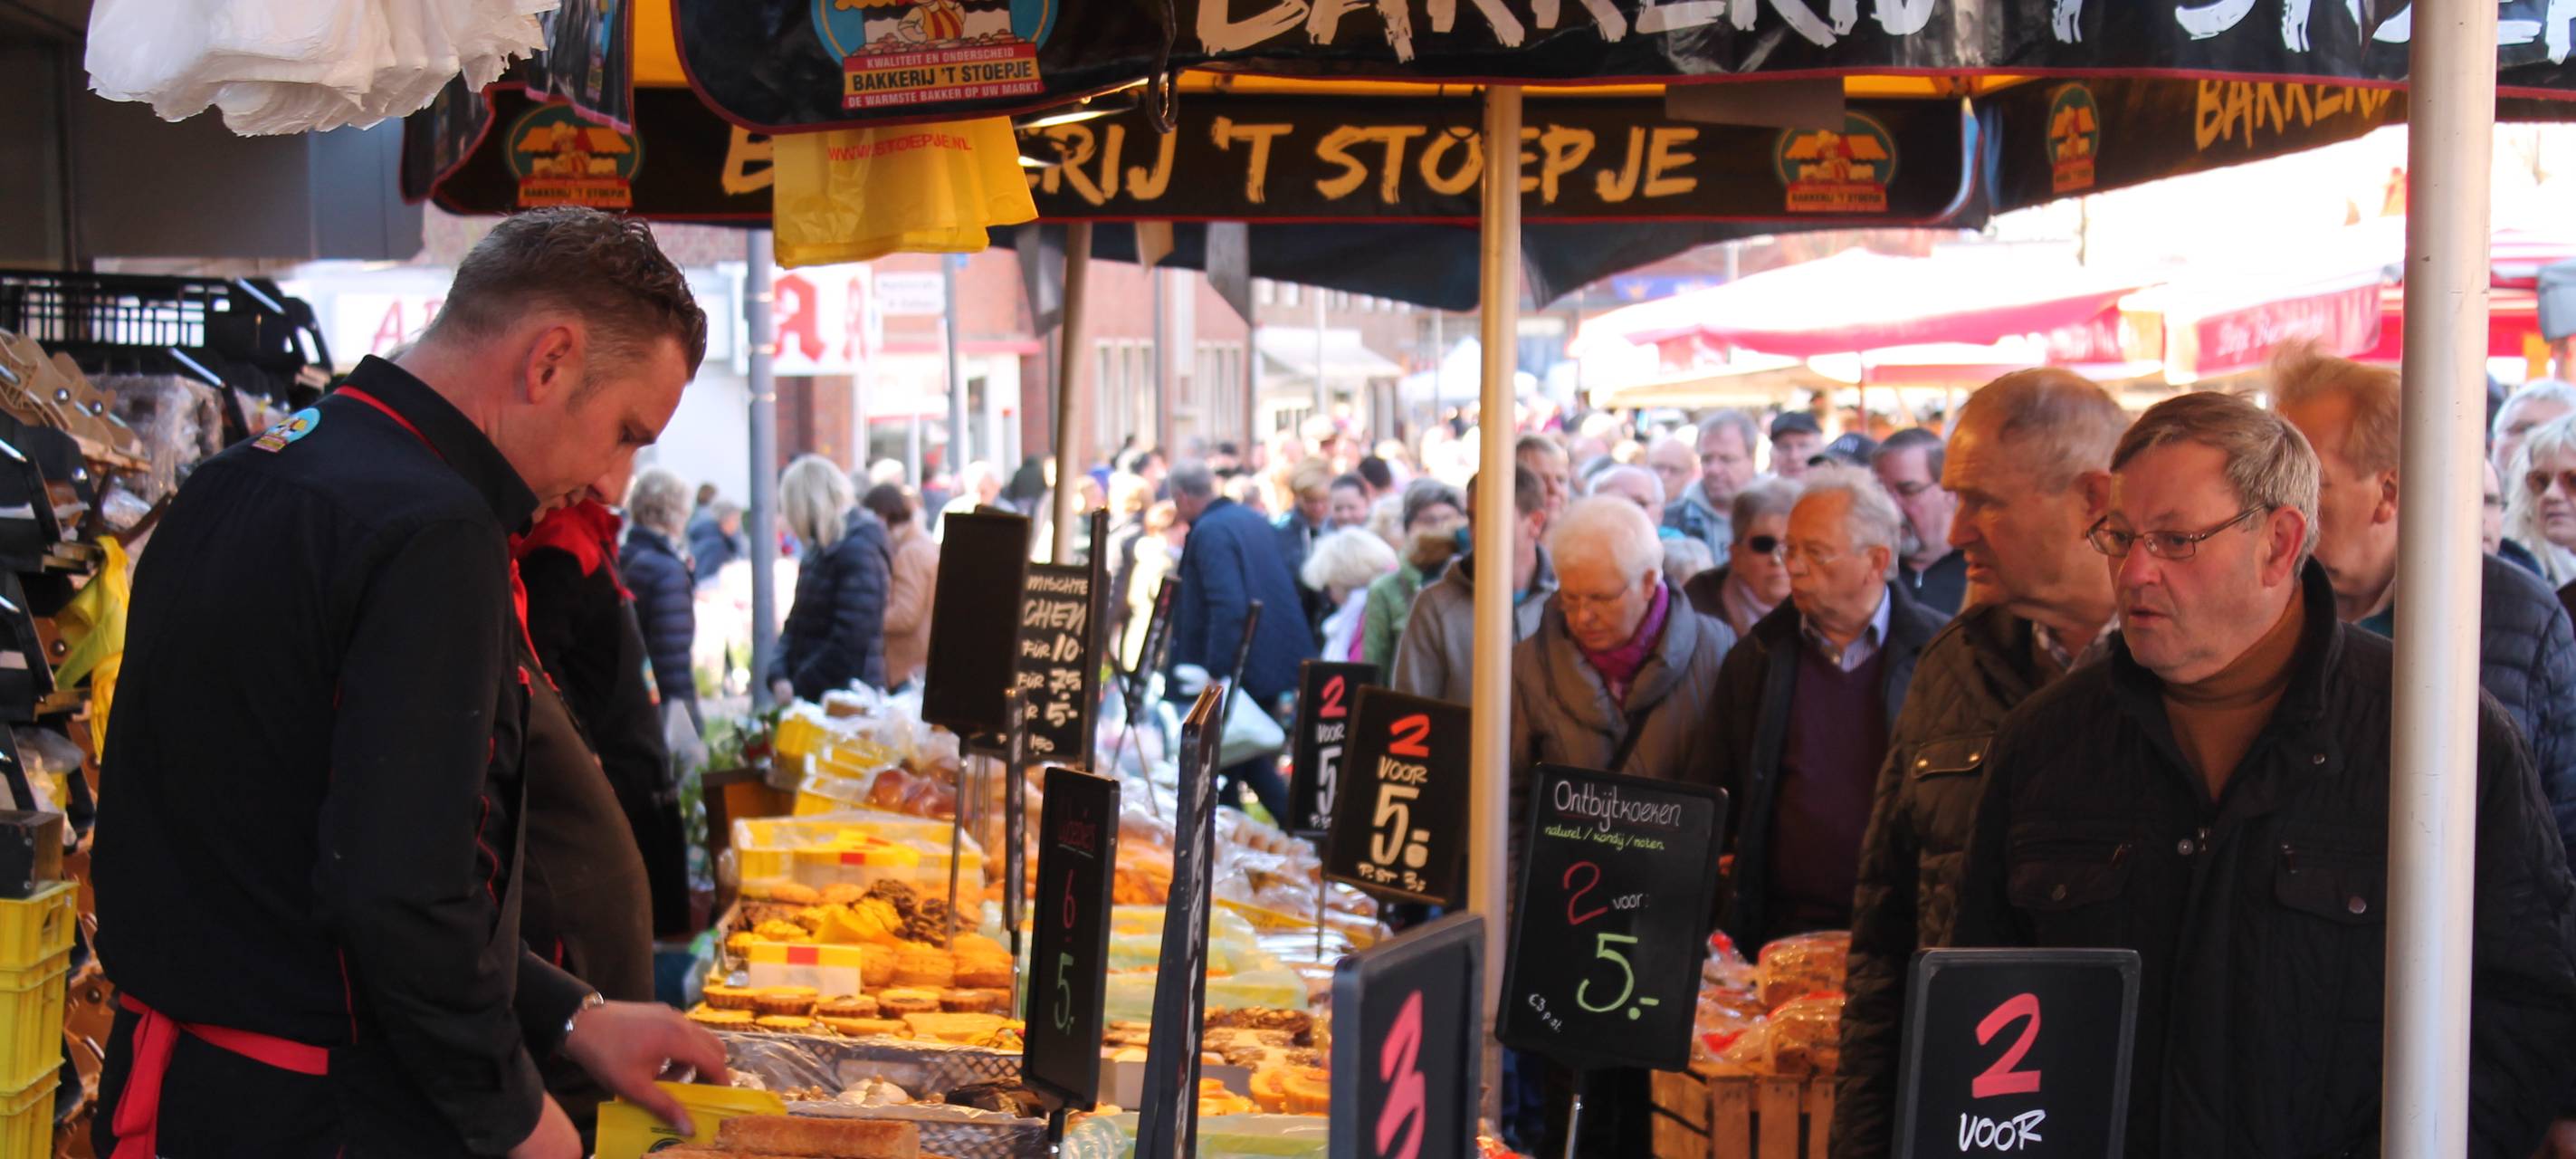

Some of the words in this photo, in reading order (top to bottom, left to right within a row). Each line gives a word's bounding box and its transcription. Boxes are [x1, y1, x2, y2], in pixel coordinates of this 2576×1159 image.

[853, 69, 936, 91] BAKKERIJ
[941, 66, 956, 83] 'T
[962, 60, 1033, 81] STOEPJE
[866, 56, 922, 69] KWALITEIT
[926, 53, 939, 64] EN
[942, 47, 1014, 62] ONDERSCHEID
[848, 95, 863, 108] DE
[865, 91, 917, 106] WARMSTE
[921, 88, 962, 102] BAKKER
[965, 86, 979, 98] OP
[982, 84, 999, 97] UW
[1002, 81, 1039, 95] MARKT
[827, 133, 972, 161] WWW.STOEPJE.NL
[1320, 675, 1348, 718] 2
[1388, 714, 1430, 758] 2
[1377, 755, 1429, 786] VOOR
[1563, 860, 1608, 925] 2
[1971, 992, 2042, 1099] 2
[1958, 1109, 2046, 1152] VOOR
